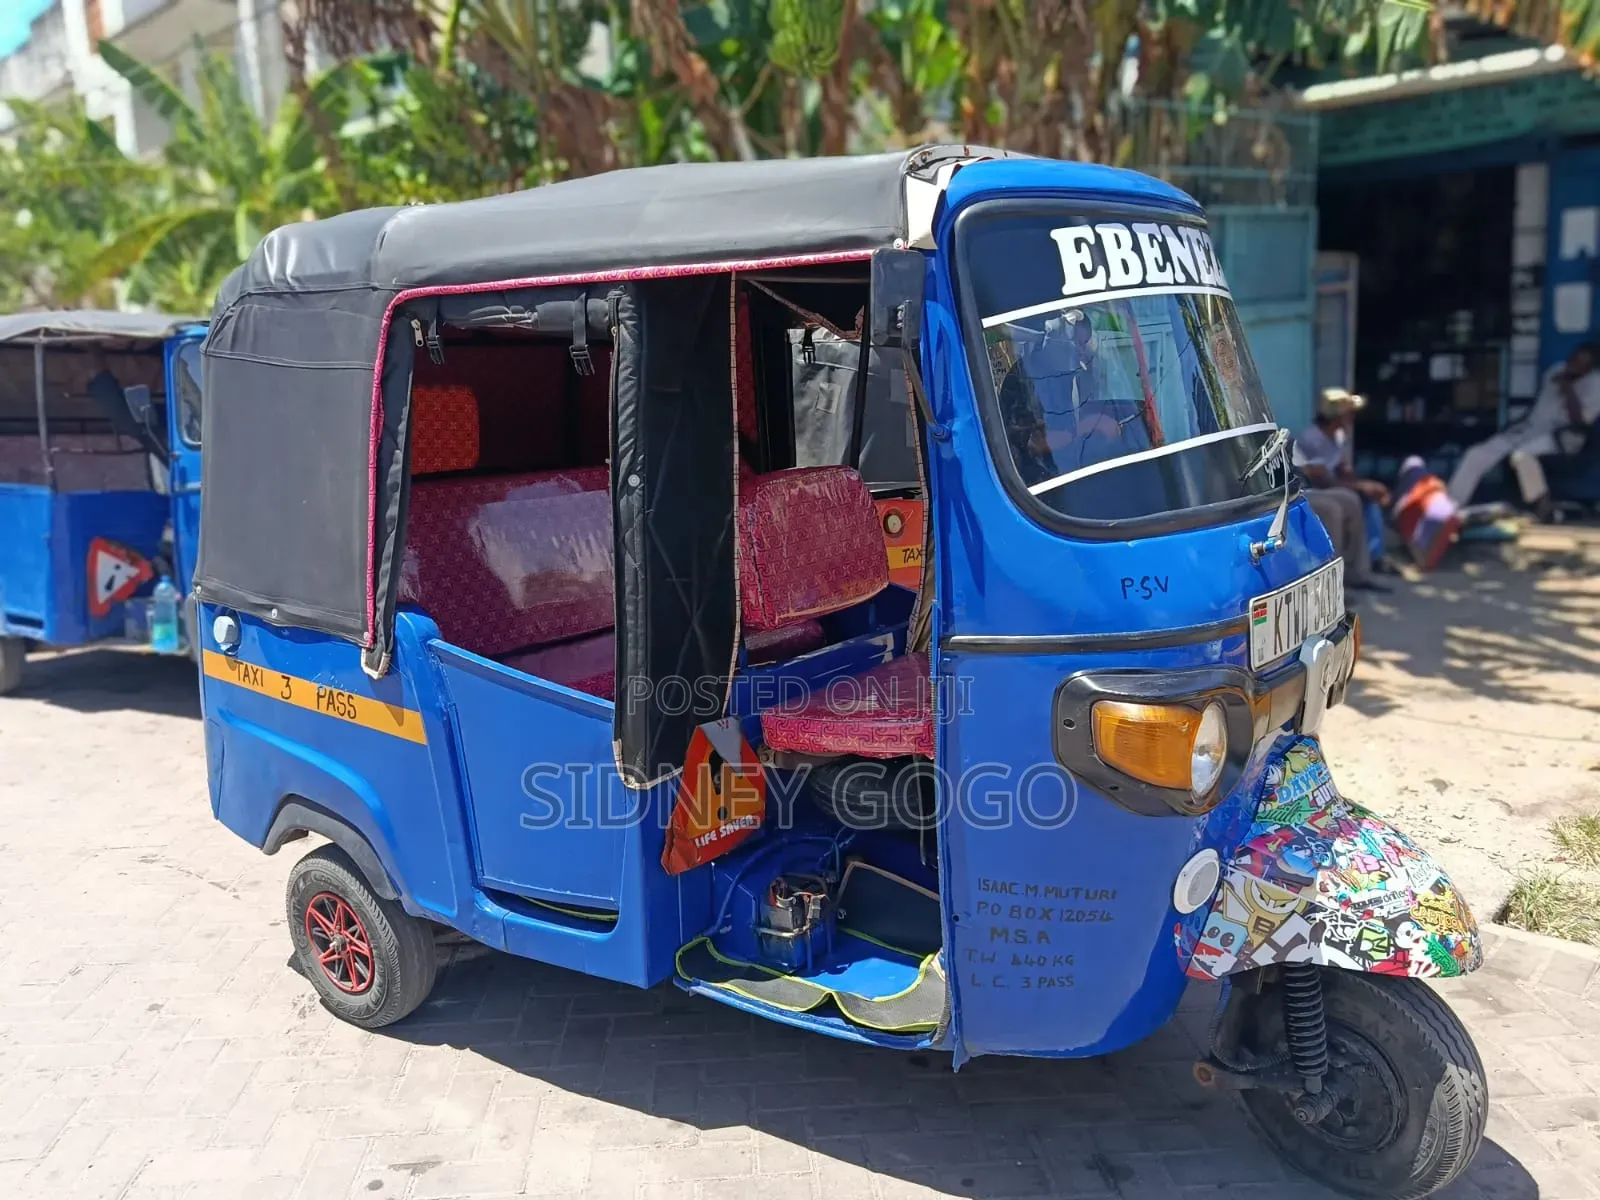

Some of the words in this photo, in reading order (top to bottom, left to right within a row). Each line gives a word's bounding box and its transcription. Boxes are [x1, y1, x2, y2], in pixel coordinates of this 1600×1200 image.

[234, 660, 264, 688] TAXI
[280, 674, 293, 700] 3
[316, 685, 358, 720] PASS
[694, 832, 718, 849] LIFE
[719, 814, 754, 839] SAVER
[1009, 904, 1055, 921] BOX
[1037, 975, 1075, 989] PASS
